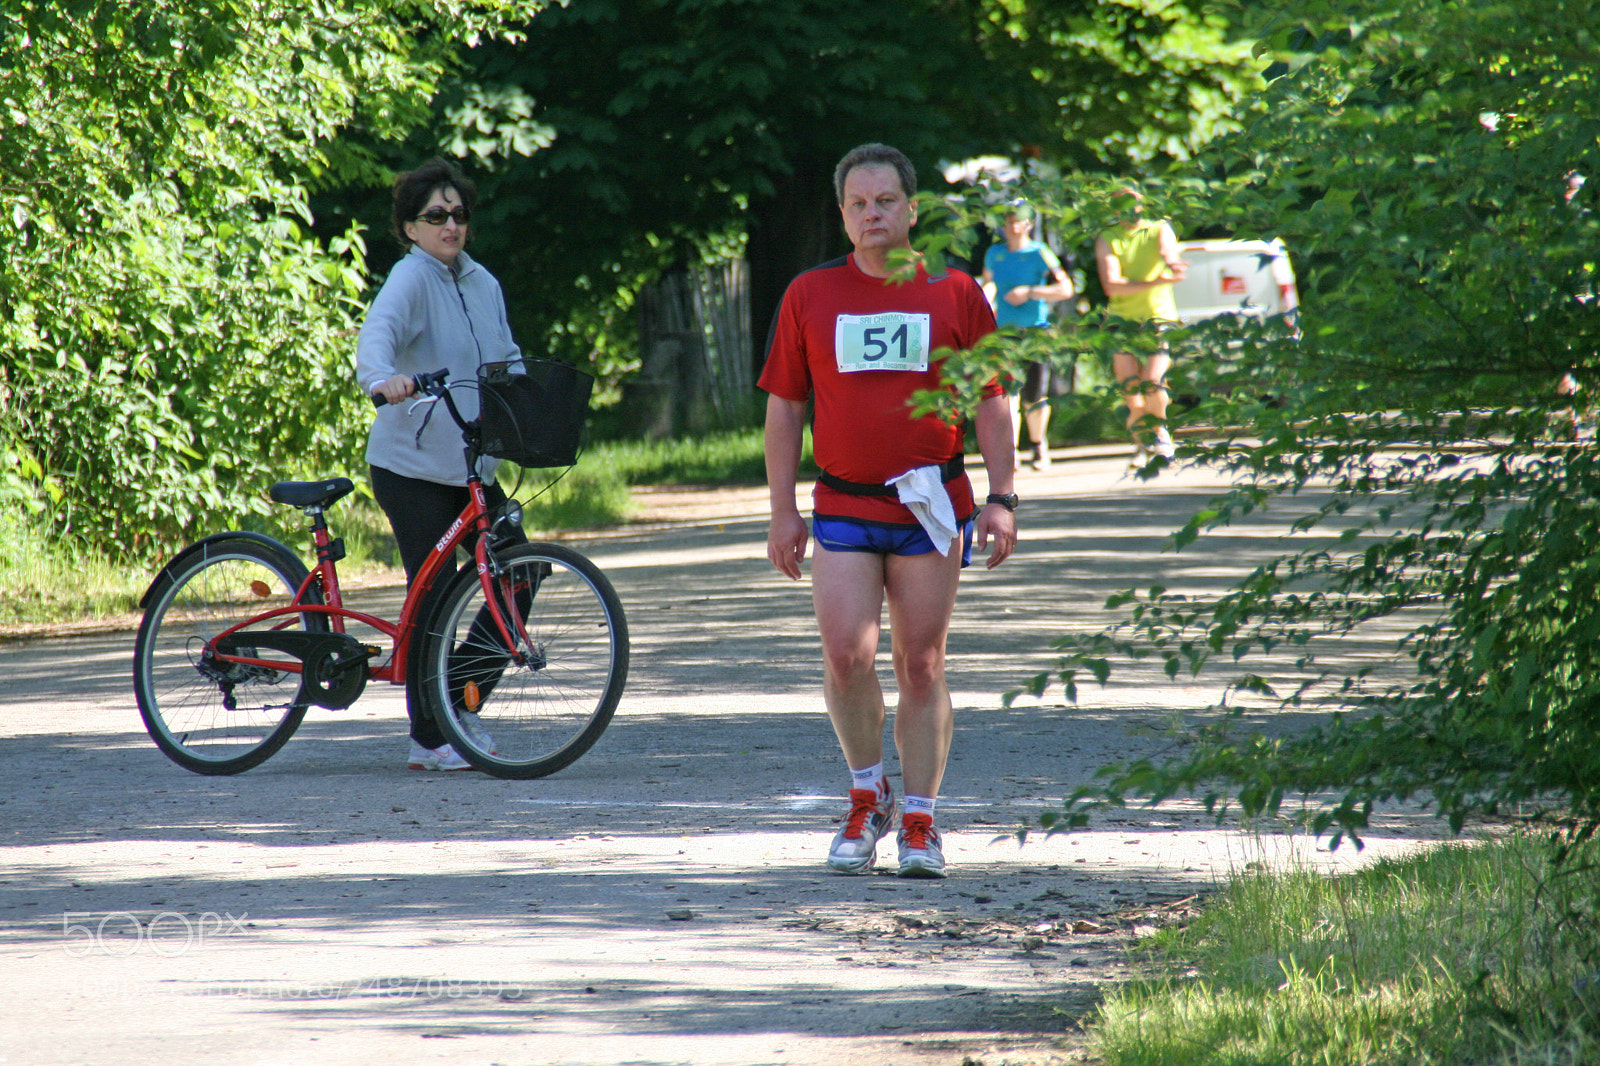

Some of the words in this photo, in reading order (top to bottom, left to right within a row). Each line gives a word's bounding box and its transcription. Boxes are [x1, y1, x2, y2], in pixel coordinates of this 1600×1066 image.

[860, 316, 872, 325] SRI
[874, 314, 906, 323] CHINMOY
[863, 323, 907, 362] 51
